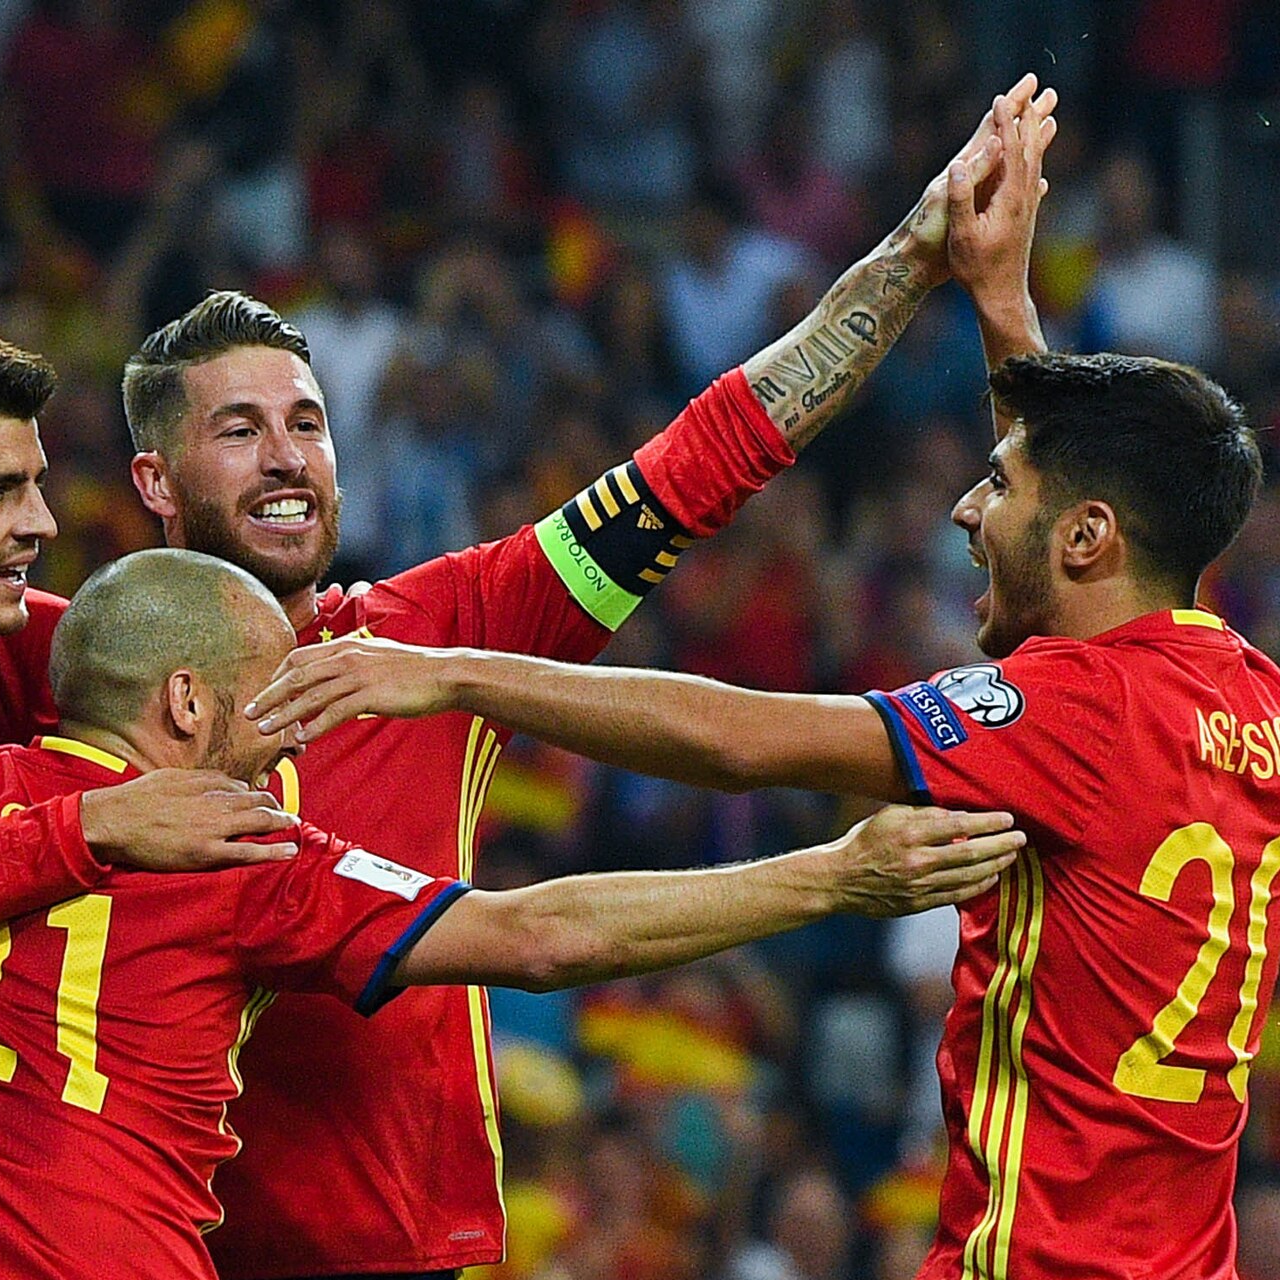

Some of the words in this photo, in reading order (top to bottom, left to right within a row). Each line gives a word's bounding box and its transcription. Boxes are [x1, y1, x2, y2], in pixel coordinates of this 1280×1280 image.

[569, 541, 588, 567] TO
[584, 566, 607, 592] NO
[909, 686, 959, 745] RESPECT
